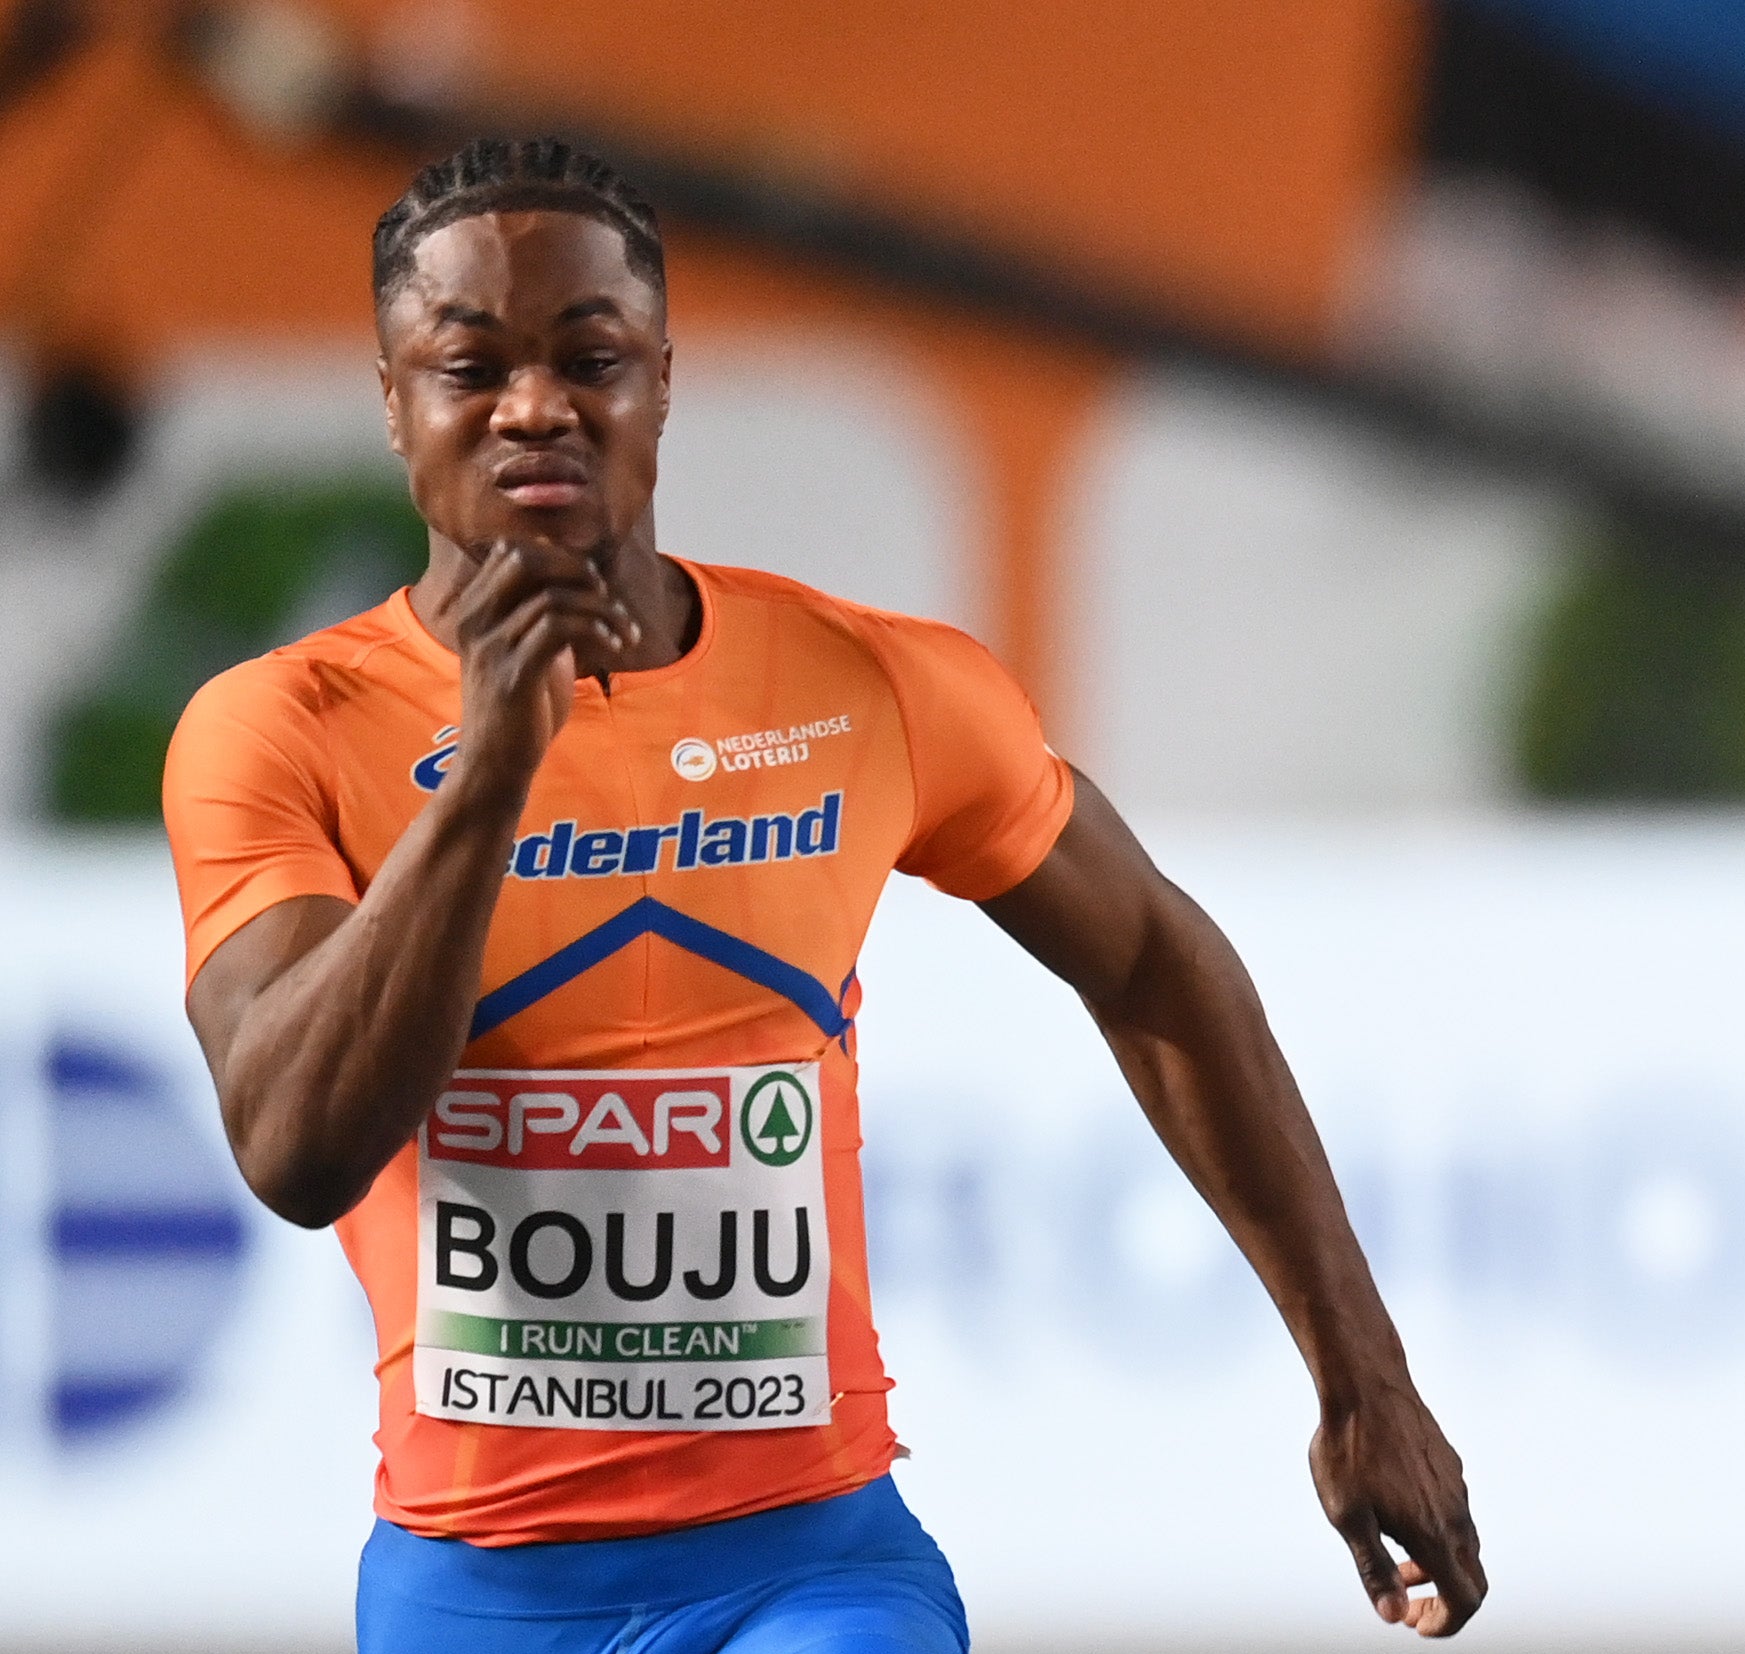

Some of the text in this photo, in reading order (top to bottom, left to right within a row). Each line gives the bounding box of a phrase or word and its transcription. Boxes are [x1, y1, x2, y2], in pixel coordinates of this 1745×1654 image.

[715, 714, 852, 755] NEDERLANDSE
[719, 742, 811, 773] LOTERIJ
[434, 1090, 724, 1157] SPAR
[436, 1200, 812, 1301] BOUJU
[499, 1324, 509, 1353] I
[520, 1324, 603, 1356] RUN
[441, 1368, 806, 1421] ISTANBUL 2023
